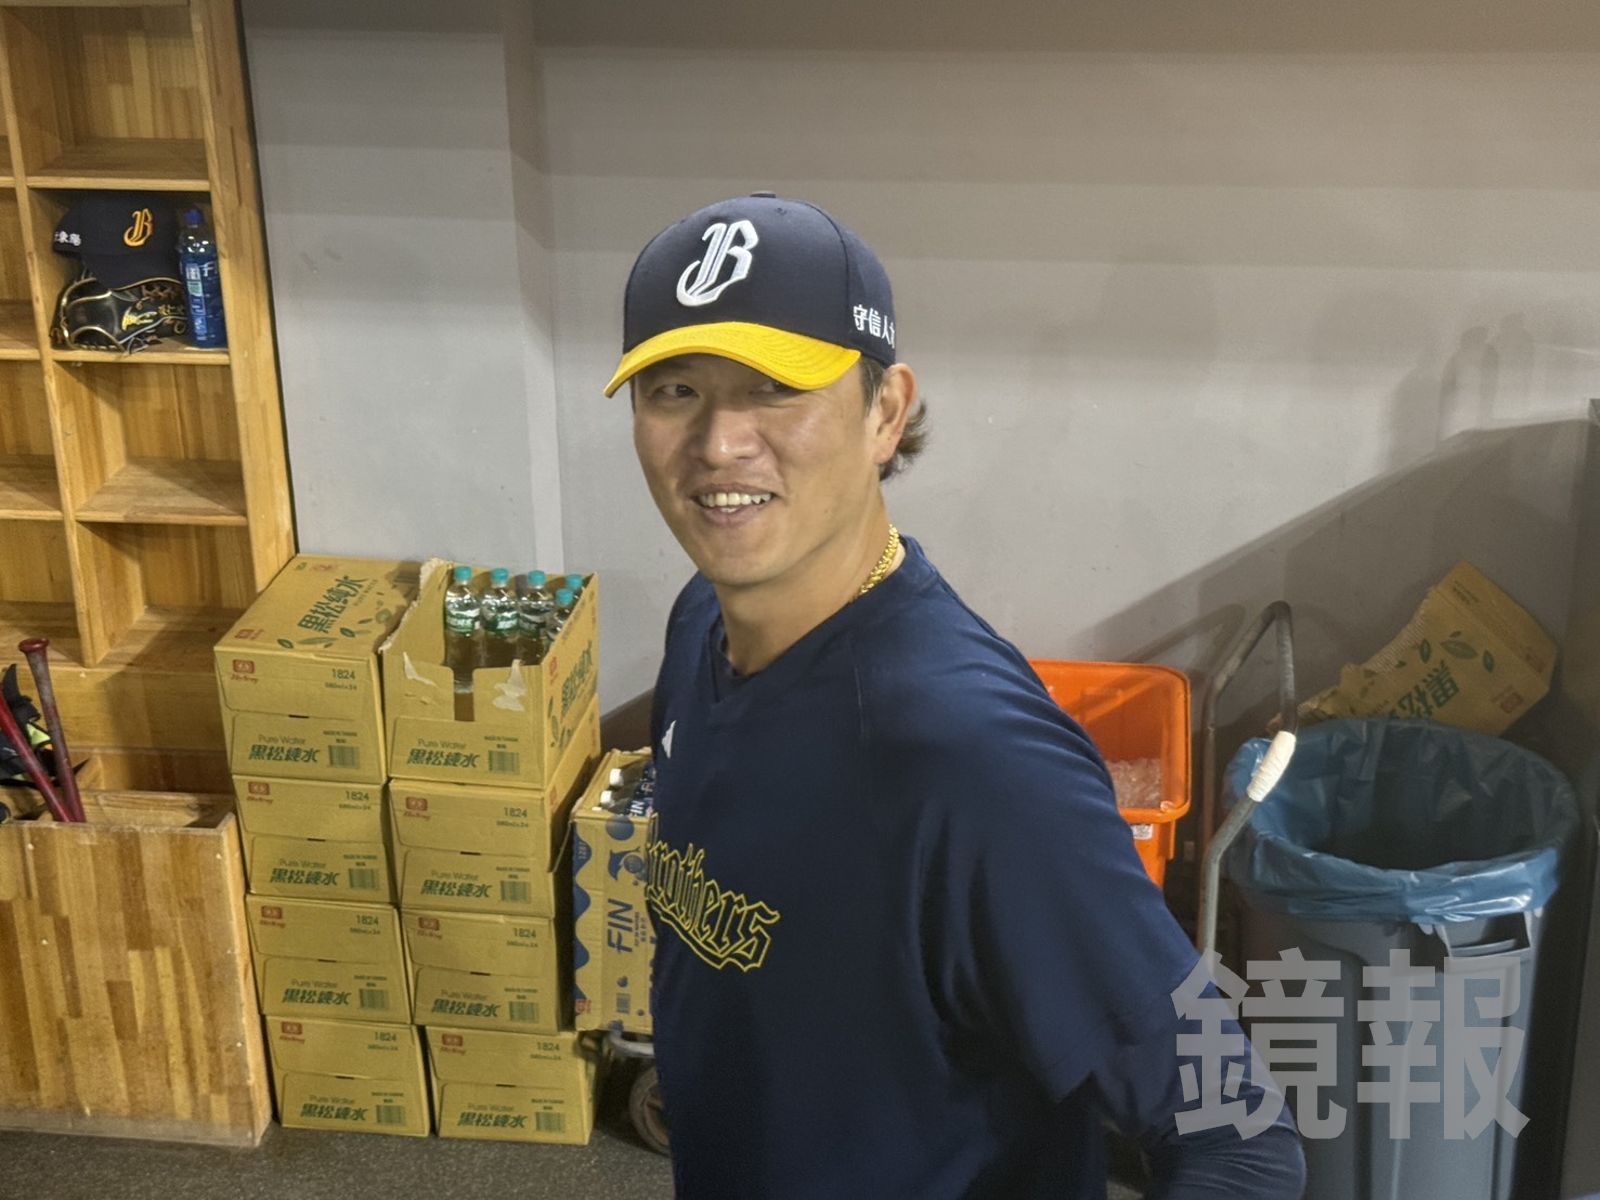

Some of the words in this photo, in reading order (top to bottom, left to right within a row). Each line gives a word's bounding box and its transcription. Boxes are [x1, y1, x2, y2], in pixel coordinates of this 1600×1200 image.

[297, 575, 369, 634] 黑松純水
[331, 668, 355, 679] 1824
[258, 734, 278, 744] Pure
[280, 736, 306, 745] Water
[249, 744, 320, 763] 黑松純水
[407, 748, 480, 768] 黑松純水
[345, 790, 369, 800] 1824
[504, 806, 528, 818] 1824
[270, 867, 341, 886] 黑松純水
[420, 879, 493, 898] 黑松純水
[645, 812, 781, 972] rothers
[356, 914, 379, 925] 1824
[607, 898, 633, 953] FIN
[513, 927, 537, 938] 1824
[282, 988, 352, 1005] 黑松純水
[431, 998, 501, 1018] 黑松純水
[374, 1031, 397, 1042] 1824
[537, 1041, 560, 1051] 1824
[301, 1103, 369, 1121] 黑松純水
[458, 1111, 528, 1128] 黑松純水
